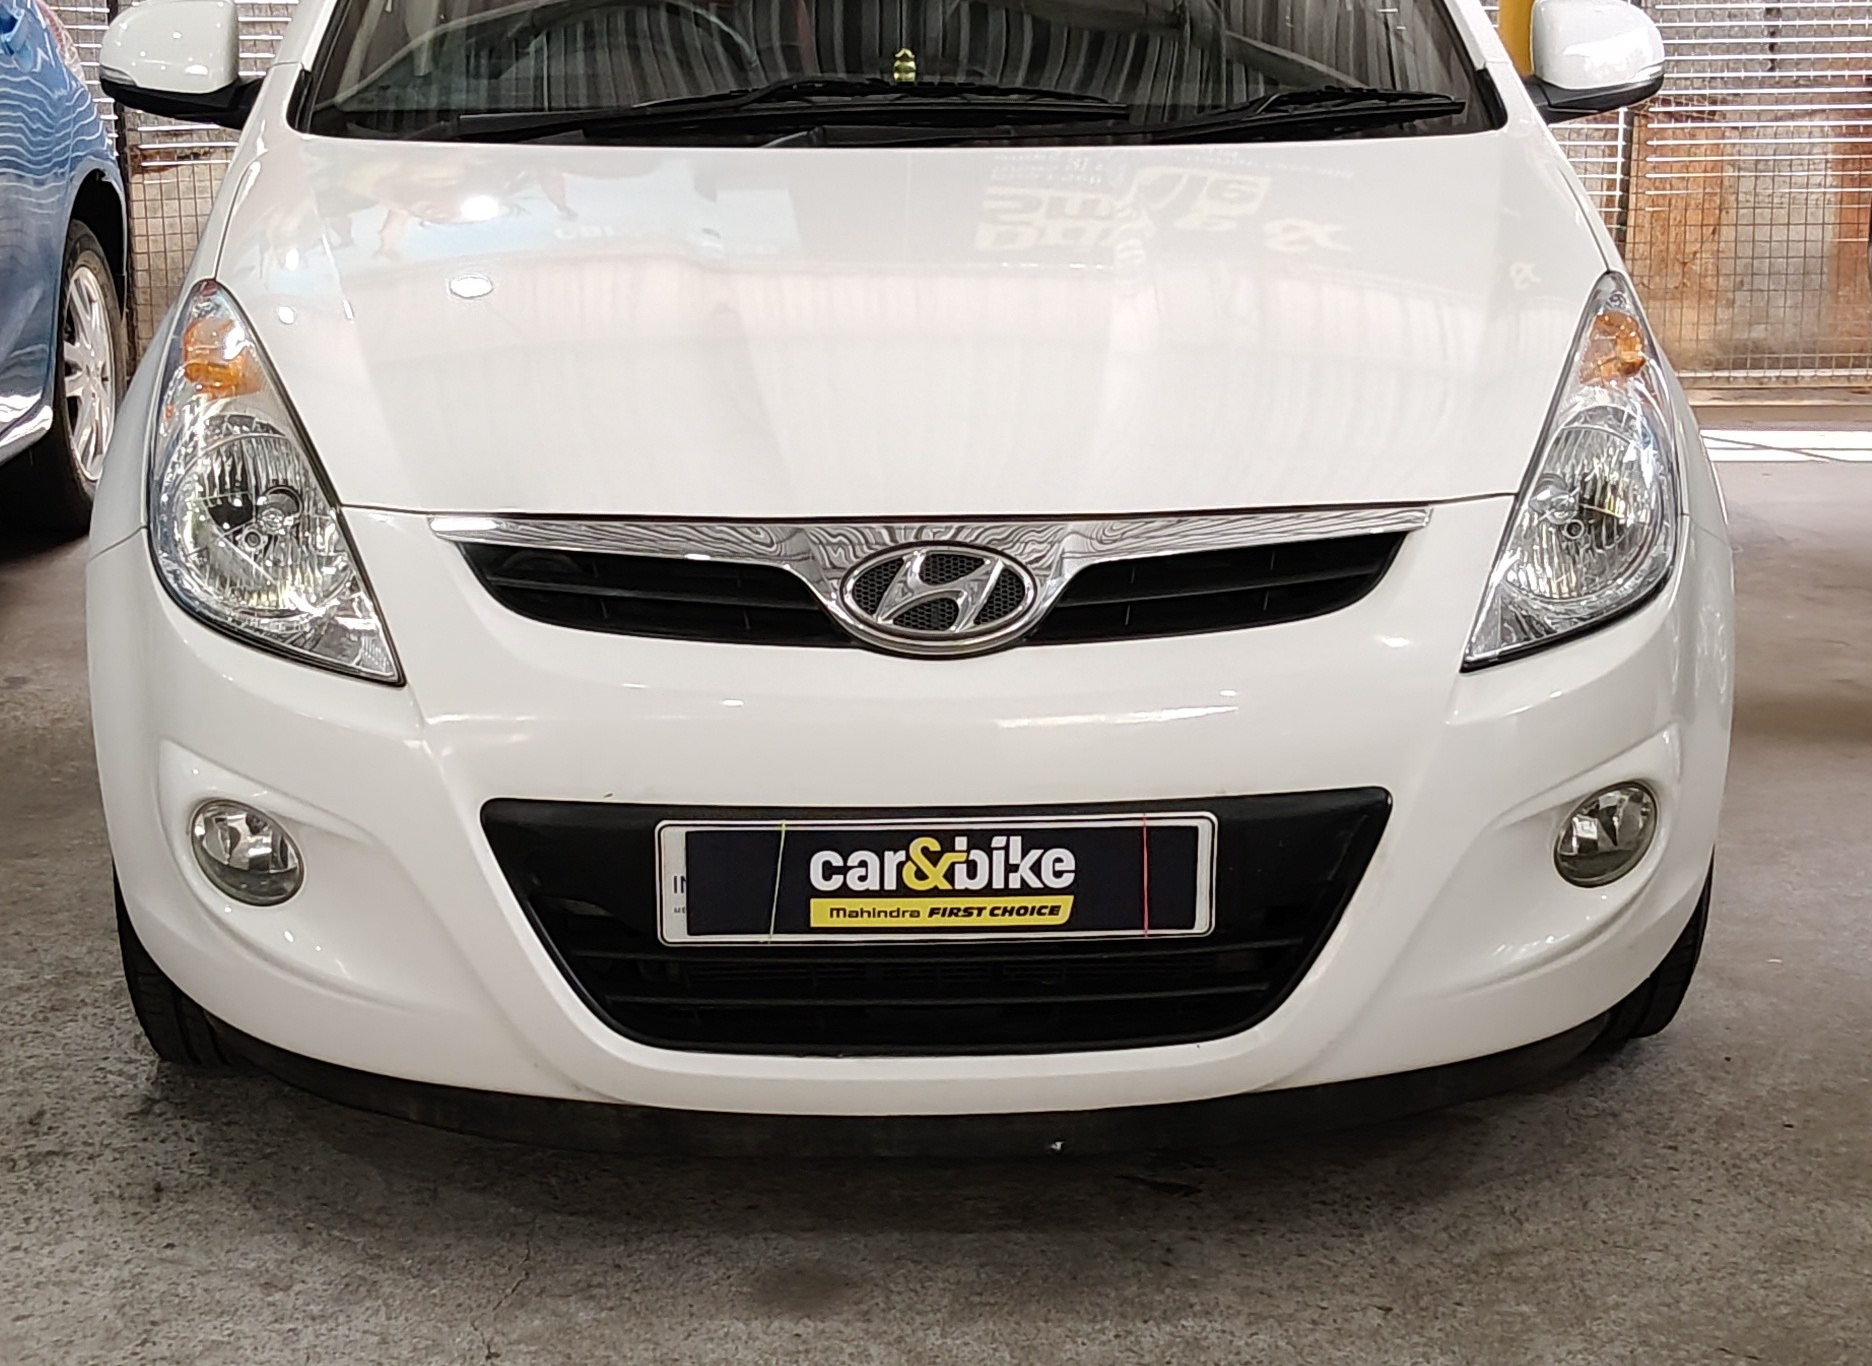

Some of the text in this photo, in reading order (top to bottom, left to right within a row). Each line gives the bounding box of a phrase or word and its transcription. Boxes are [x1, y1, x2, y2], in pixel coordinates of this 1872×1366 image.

[809, 835, 1076, 892] car&bike
[829, 904, 1062, 920] Mahindra FIRST CHOICE
